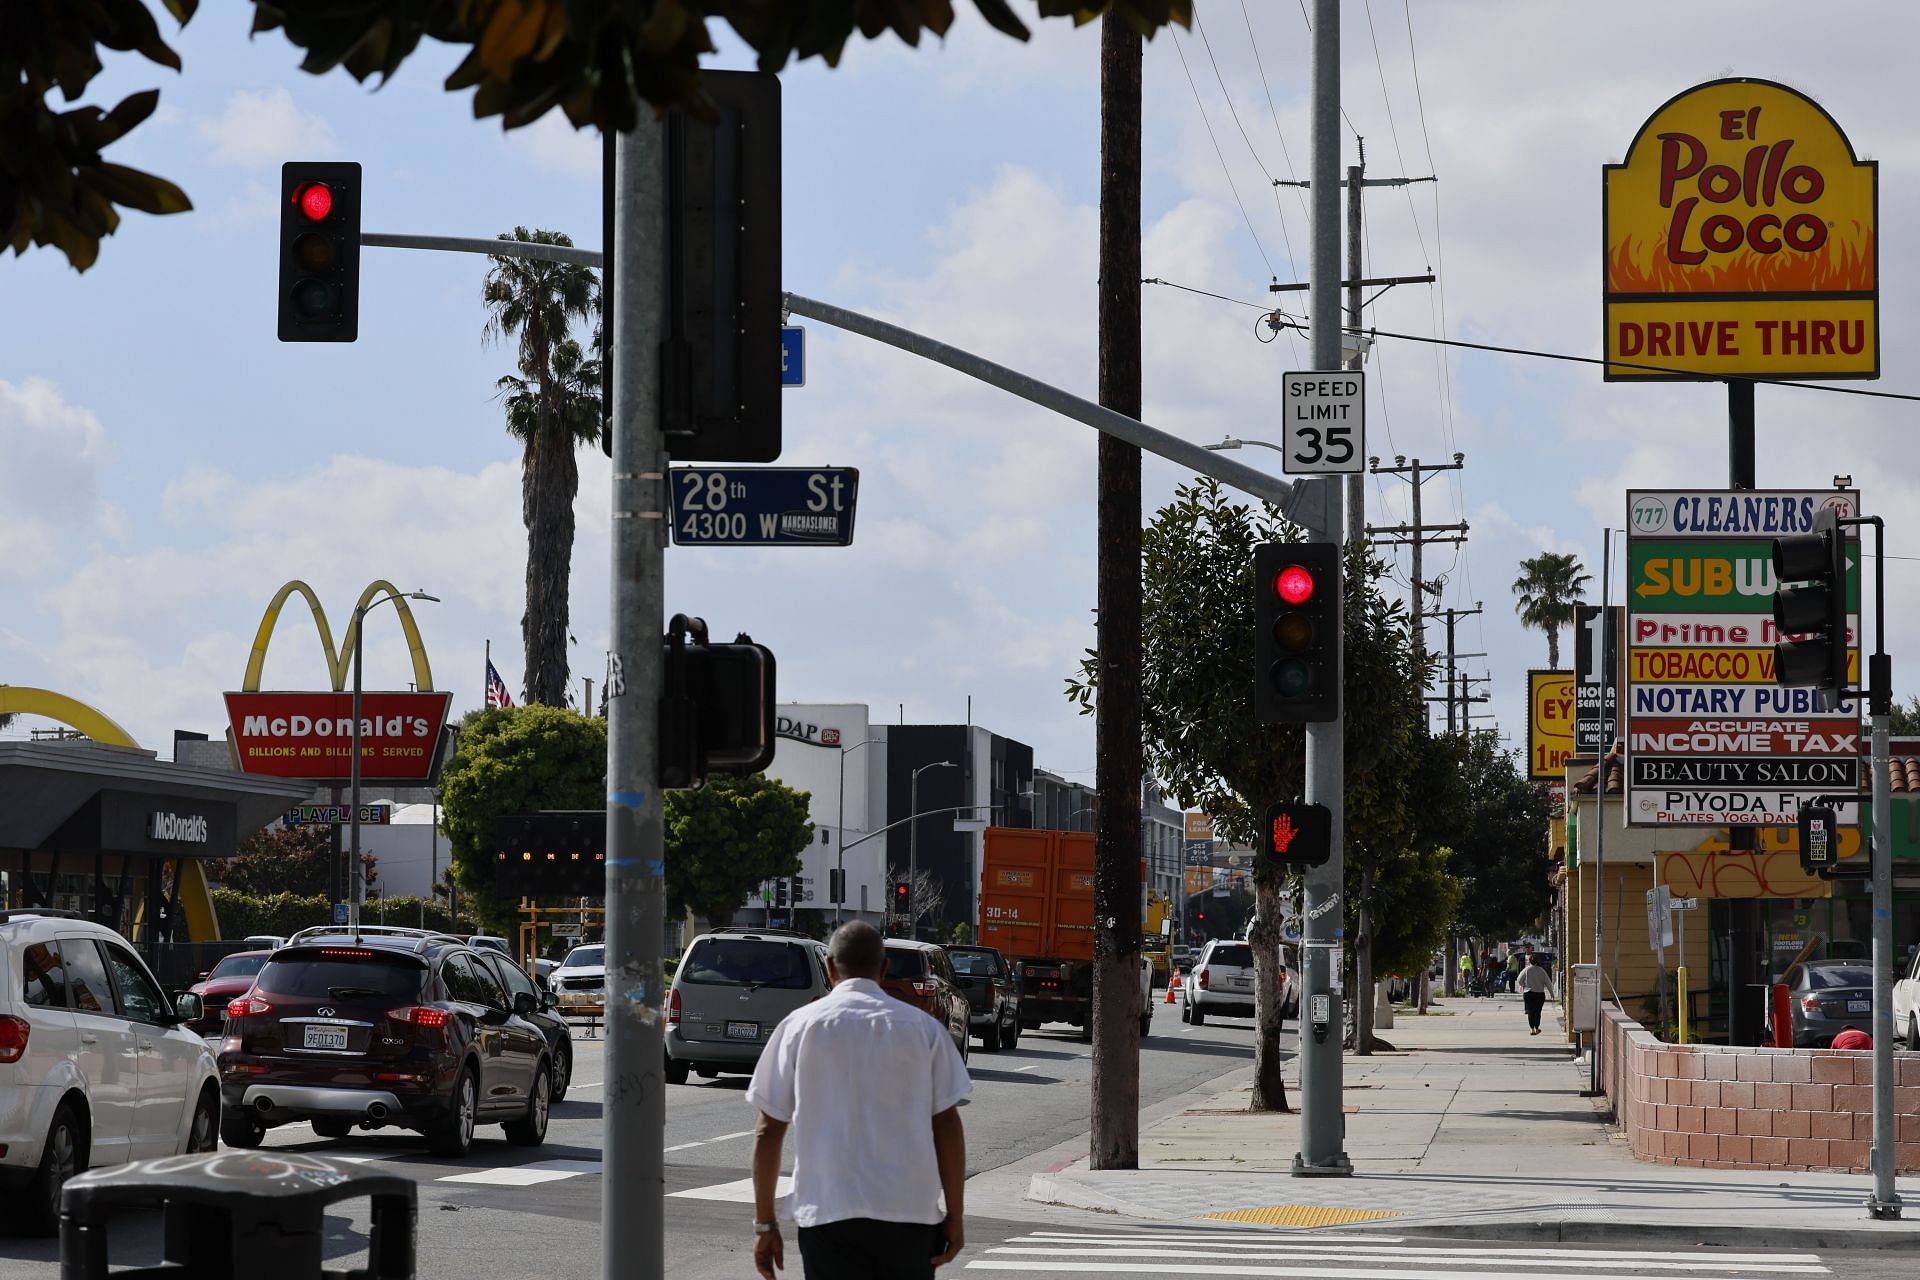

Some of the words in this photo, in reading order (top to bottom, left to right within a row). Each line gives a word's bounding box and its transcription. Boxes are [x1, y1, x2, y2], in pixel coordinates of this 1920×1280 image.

[1719, 106, 1762, 140] El
[1657, 132, 1825, 208] Pollo
[1667, 197, 1828, 265] Loco
[1619, 321, 1740, 357] DRIVE
[1755, 320, 1865, 356] THRU
[1290, 381, 1358, 397] SPEED
[1298, 404, 1350, 420] LIMIT
[1294, 427, 1354, 464] 35
[682, 472, 746, 511] 28th
[806, 473, 845, 512] St
[682, 513, 747, 539] 4300
[760, 513, 779, 538] W
[1634, 508, 1664, 525] 777
[1673, 496, 1814, 533] CLEANERS
[1635, 558, 1808, 599] SUBW
[1636, 618, 1750, 644] Prime
[1585, 613, 1607, 683] 1
[1634, 652, 1750, 680] TOBACCO
[1543, 699, 1574, 719] EY
[1577, 699, 1615, 708] SERVCE
[1637, 688, 1746, 713] NOTARY
[1755, 688, 1854, 714] PUBLC
[242, 715, 429, 737] McDonald's
[1579, 723, 1613, 732] DISCONT
[1585, 734, 1608, 743] PRICS
[1688, 721, 1809, 733] ACCURATE
[249, 747, 296, 757] BILLIONS
[301, 747, 321, 757] AND
[326, 747, 375, 757] BILLINS
[383, 747, 424, 757] SERVED
[1631, 733, 1772, 752] INCOME
[1783, 734, 1858, 753] TAX
[1536, 744, 1548, 771] 1
[1641, 762, 1750, 782] BEAUTY
[1757, 763, 1848, 783] SALON
[155, 811, 207, 843] McDonald's
[1656, 812, 1714, 823] PILATES
[1720, 812, 1759, 823] YOGA
